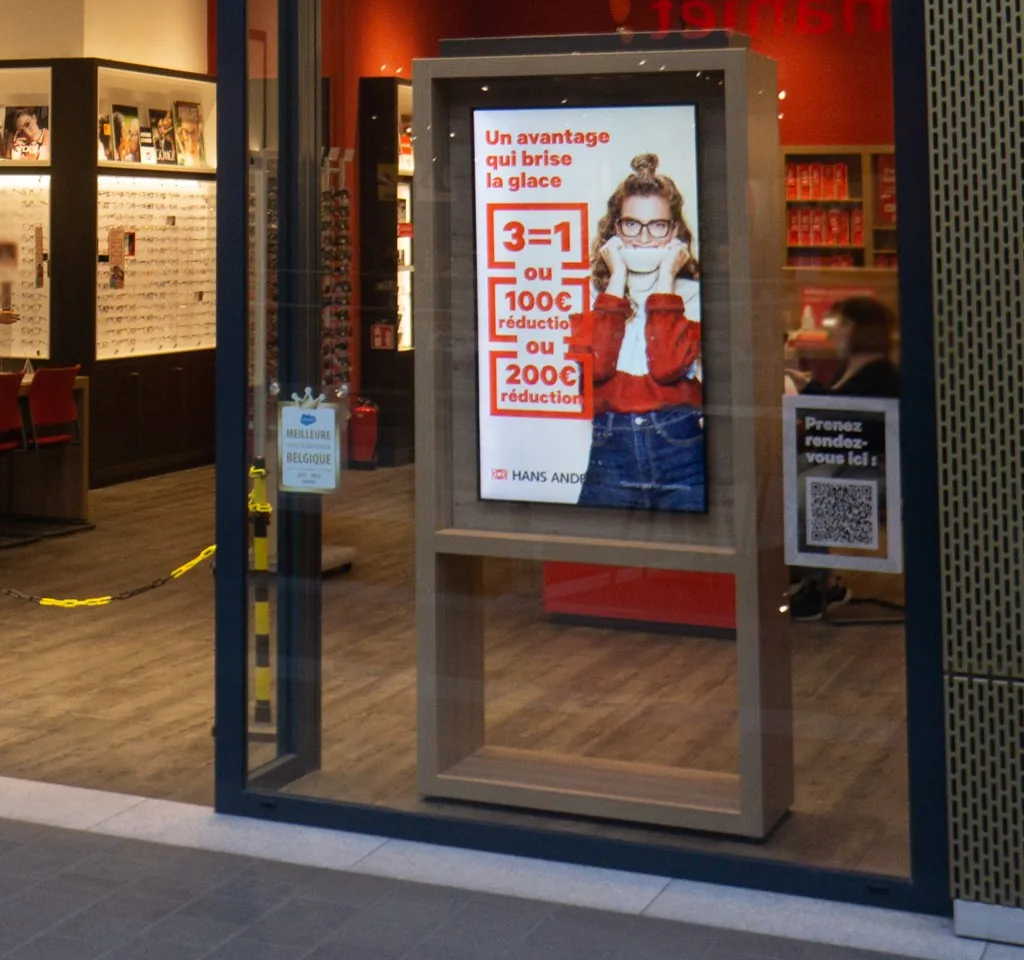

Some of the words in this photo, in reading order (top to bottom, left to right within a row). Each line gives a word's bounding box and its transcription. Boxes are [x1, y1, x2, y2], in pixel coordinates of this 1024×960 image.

[485, 129, 512, 145] Un
[517, 127, 610, 147] avantage
[485, 150, 517, 170] qui
[521, 149, 573, 167] brise
[486, 172, 504, 188] la
[508, 171, 562, 192] glace
[502, 220, 571, 252] 3=1
[524, 266, 552, 281] ou
[504, 289, 572, 312] 100€
[498, 315, 570, 330] réductio
[525, 340, 554, 355] ou
[505, 363, 577, 387] 200€
[501, 388, 584, 405] réduction
[806, 417, 862, 432] Prenez
[286, 429, 331, 440] MEILLEURE
[805, 434, 868, 449] rendez-
[286, 452, 331, 465] BELGIQUE
[806, 453, 845, 465] vous
[848, 451, 868, 466] ici
[512, 470, 548, 482] HANS
[551, 472, 587, 485] ANDE
